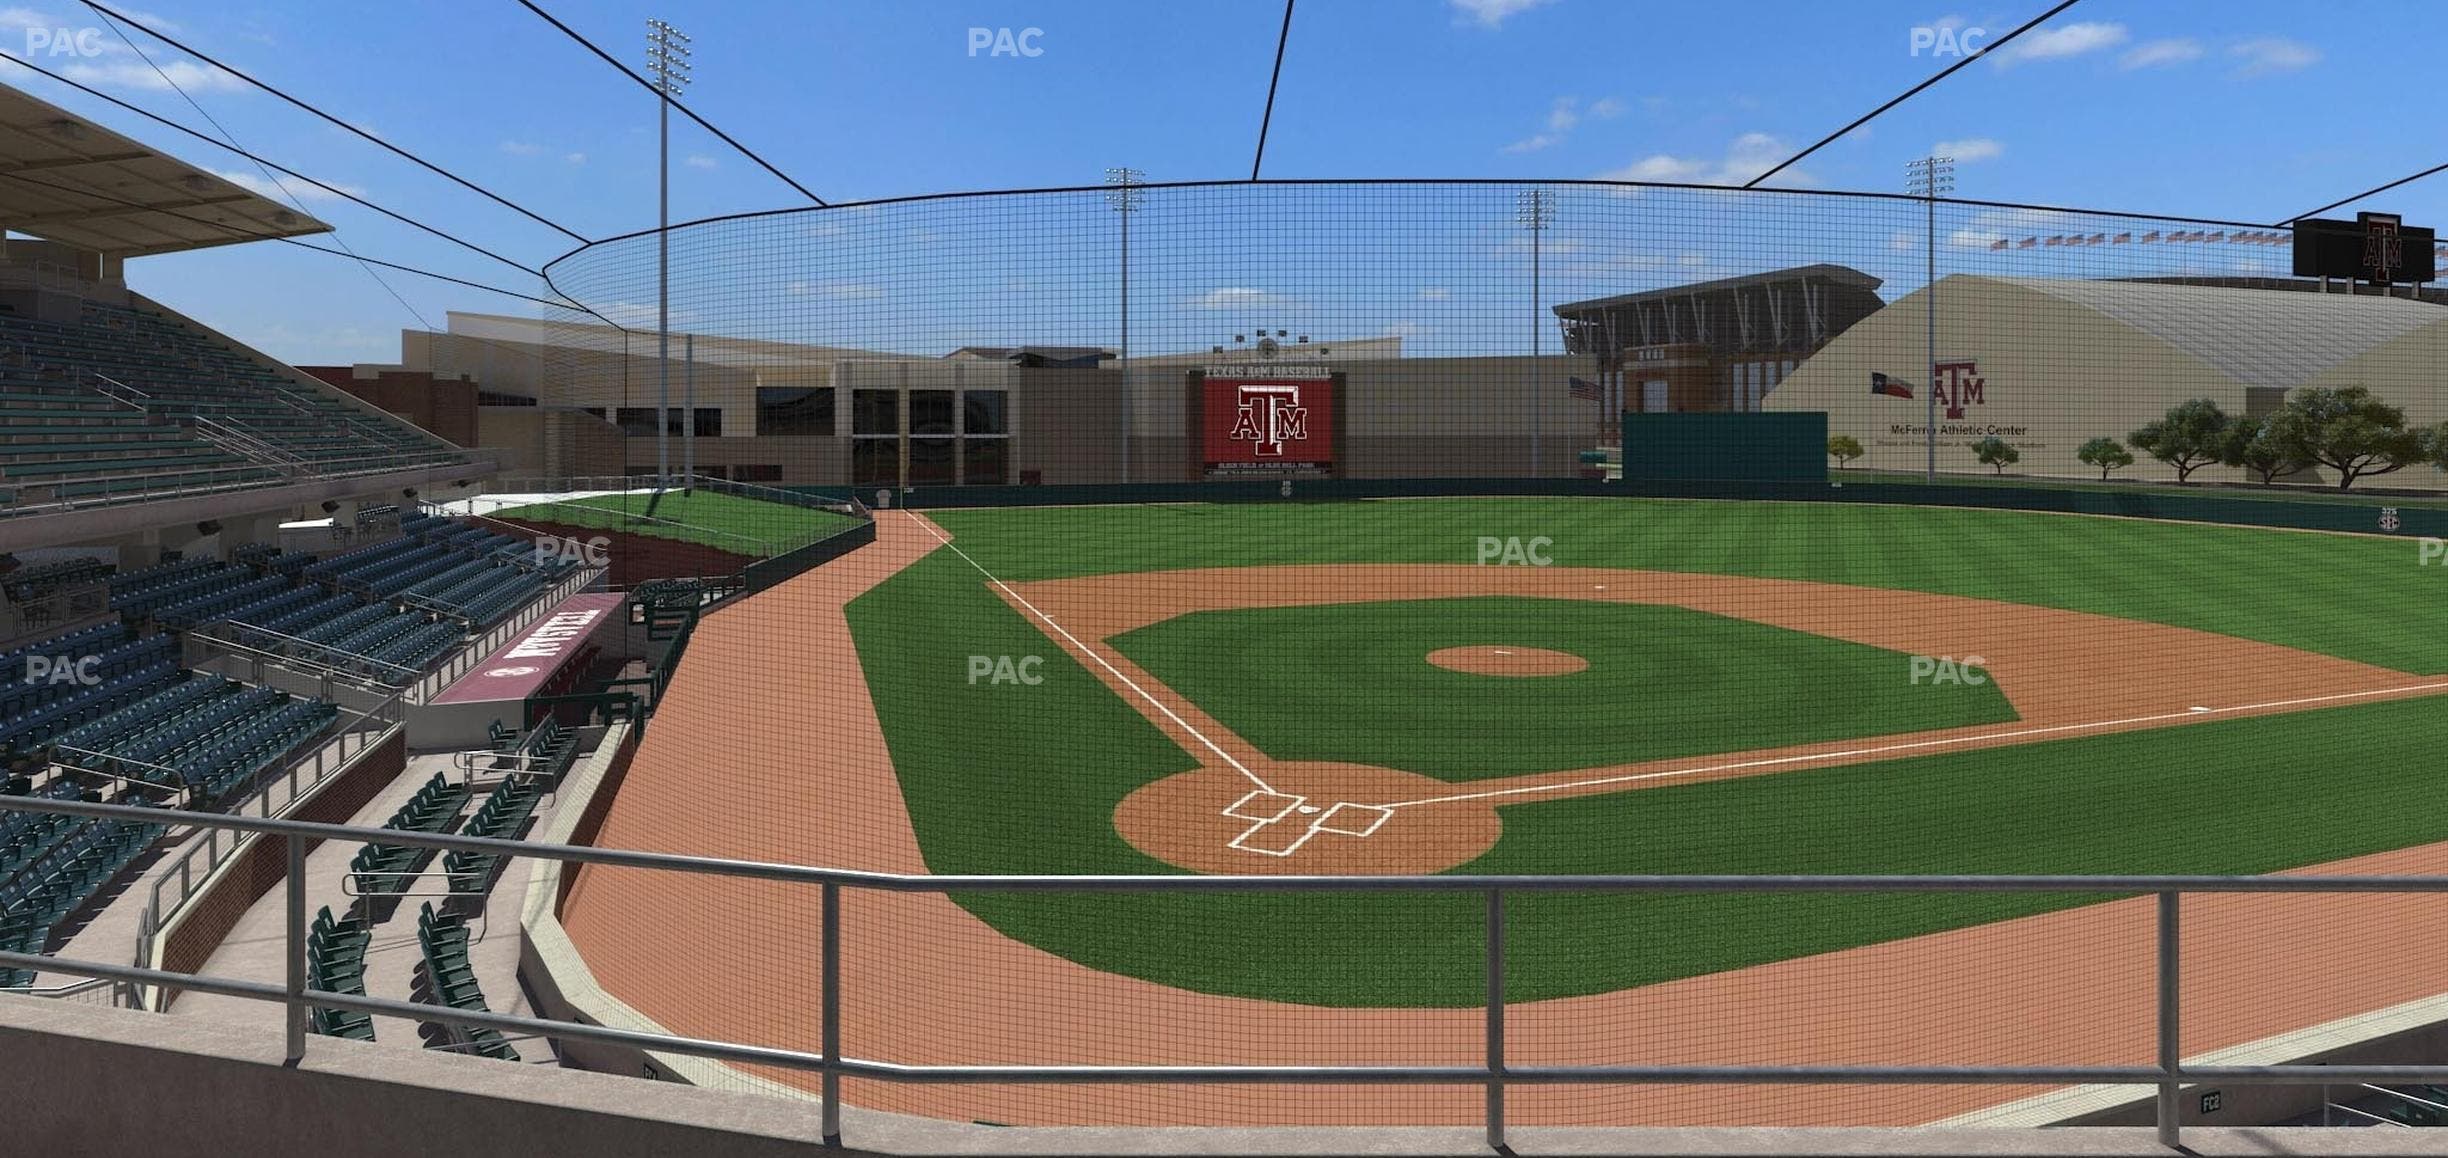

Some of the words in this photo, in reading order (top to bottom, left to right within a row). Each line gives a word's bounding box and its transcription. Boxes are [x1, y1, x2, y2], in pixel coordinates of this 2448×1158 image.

[1204, 366, 1244, 378] TEXAS
[1247, 366, 1270, 378] A&M
[1273, 366, 1332, 379] BASEBALL
[1891, 424, 1936, 435] McFerr
[1940, 424, 1983, 436] Athletic
[1987, 424, 2027, 436] Center
[2203, 1094, 2219, 1111] FC2
